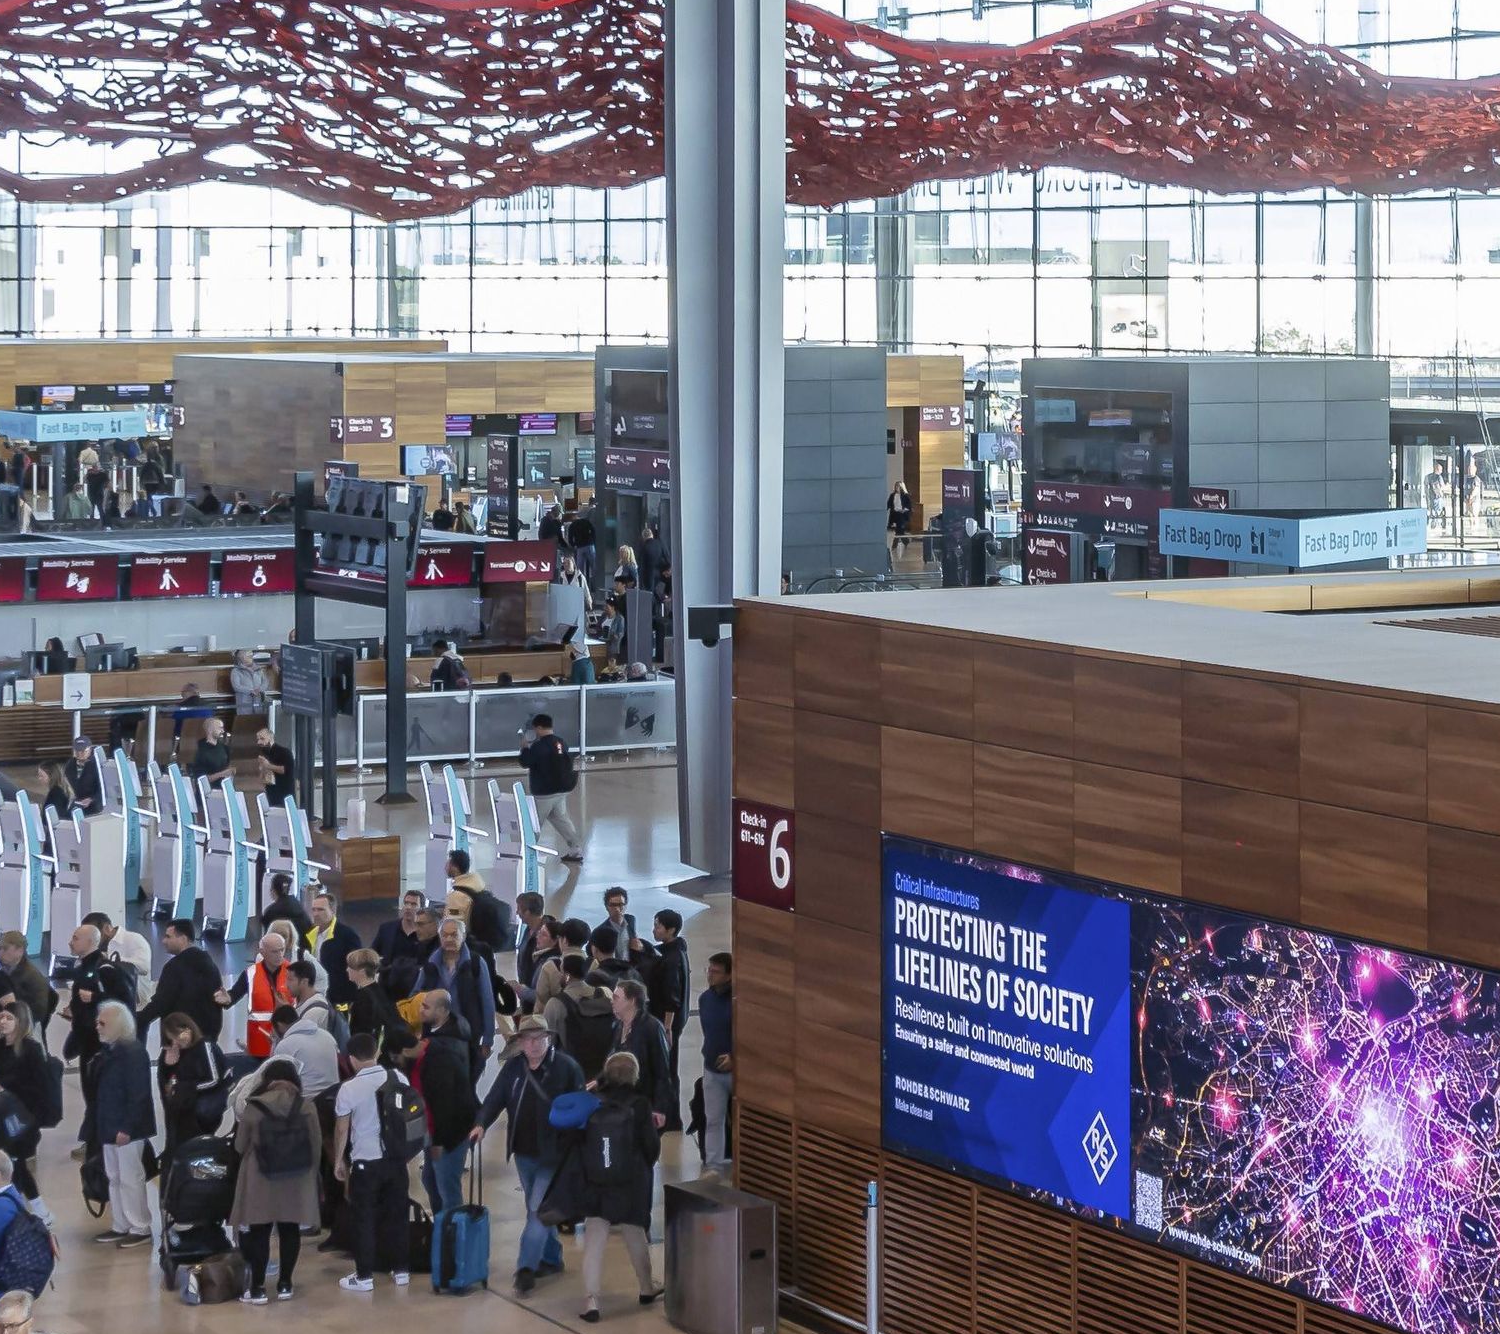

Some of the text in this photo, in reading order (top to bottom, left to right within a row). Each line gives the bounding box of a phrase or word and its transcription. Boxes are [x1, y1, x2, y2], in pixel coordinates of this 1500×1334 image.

[41, 421, 104, 436] Fast Bag Drop
[380, 417, 393, 438] 3
[950, 407, 961, 426] 3
[1164, 524, 1187, 544] Fast
[1190, 527, 1211, 550] Bag
[1214, 531, 1242, 554] Drop
[1304, 534, 1326, 554] Fast
[1330, 532, 1350, 554] Bag
[1352, 529, 1378, 550] Drop
[135, 556, 187, 566] Mobility Service
[226, 553, 277, 564] Mobility Service
[1036, 568, 1057, 579] Check-in
[740, 810, 767, 829] Check-in
[769, 819, 791, 890] 6
[894, 870, 980, 911] Critical infrastructures
[894, 896, 1047, 974] PROTECTING THE
[894, 943, 1094, 1035] LIFELINES OF SOCIETY
[894, 995, 1093, 1074] Resilience built on innovative solutions
[894, 1023, 1034, 1079] Ensuring a safer and connected world
[894, 1097, 909, 1112] Make
[909, 1100, 923, 1118] ideas
[1168, 1225, 1261, 1267] www.rohde-schwarz.com
